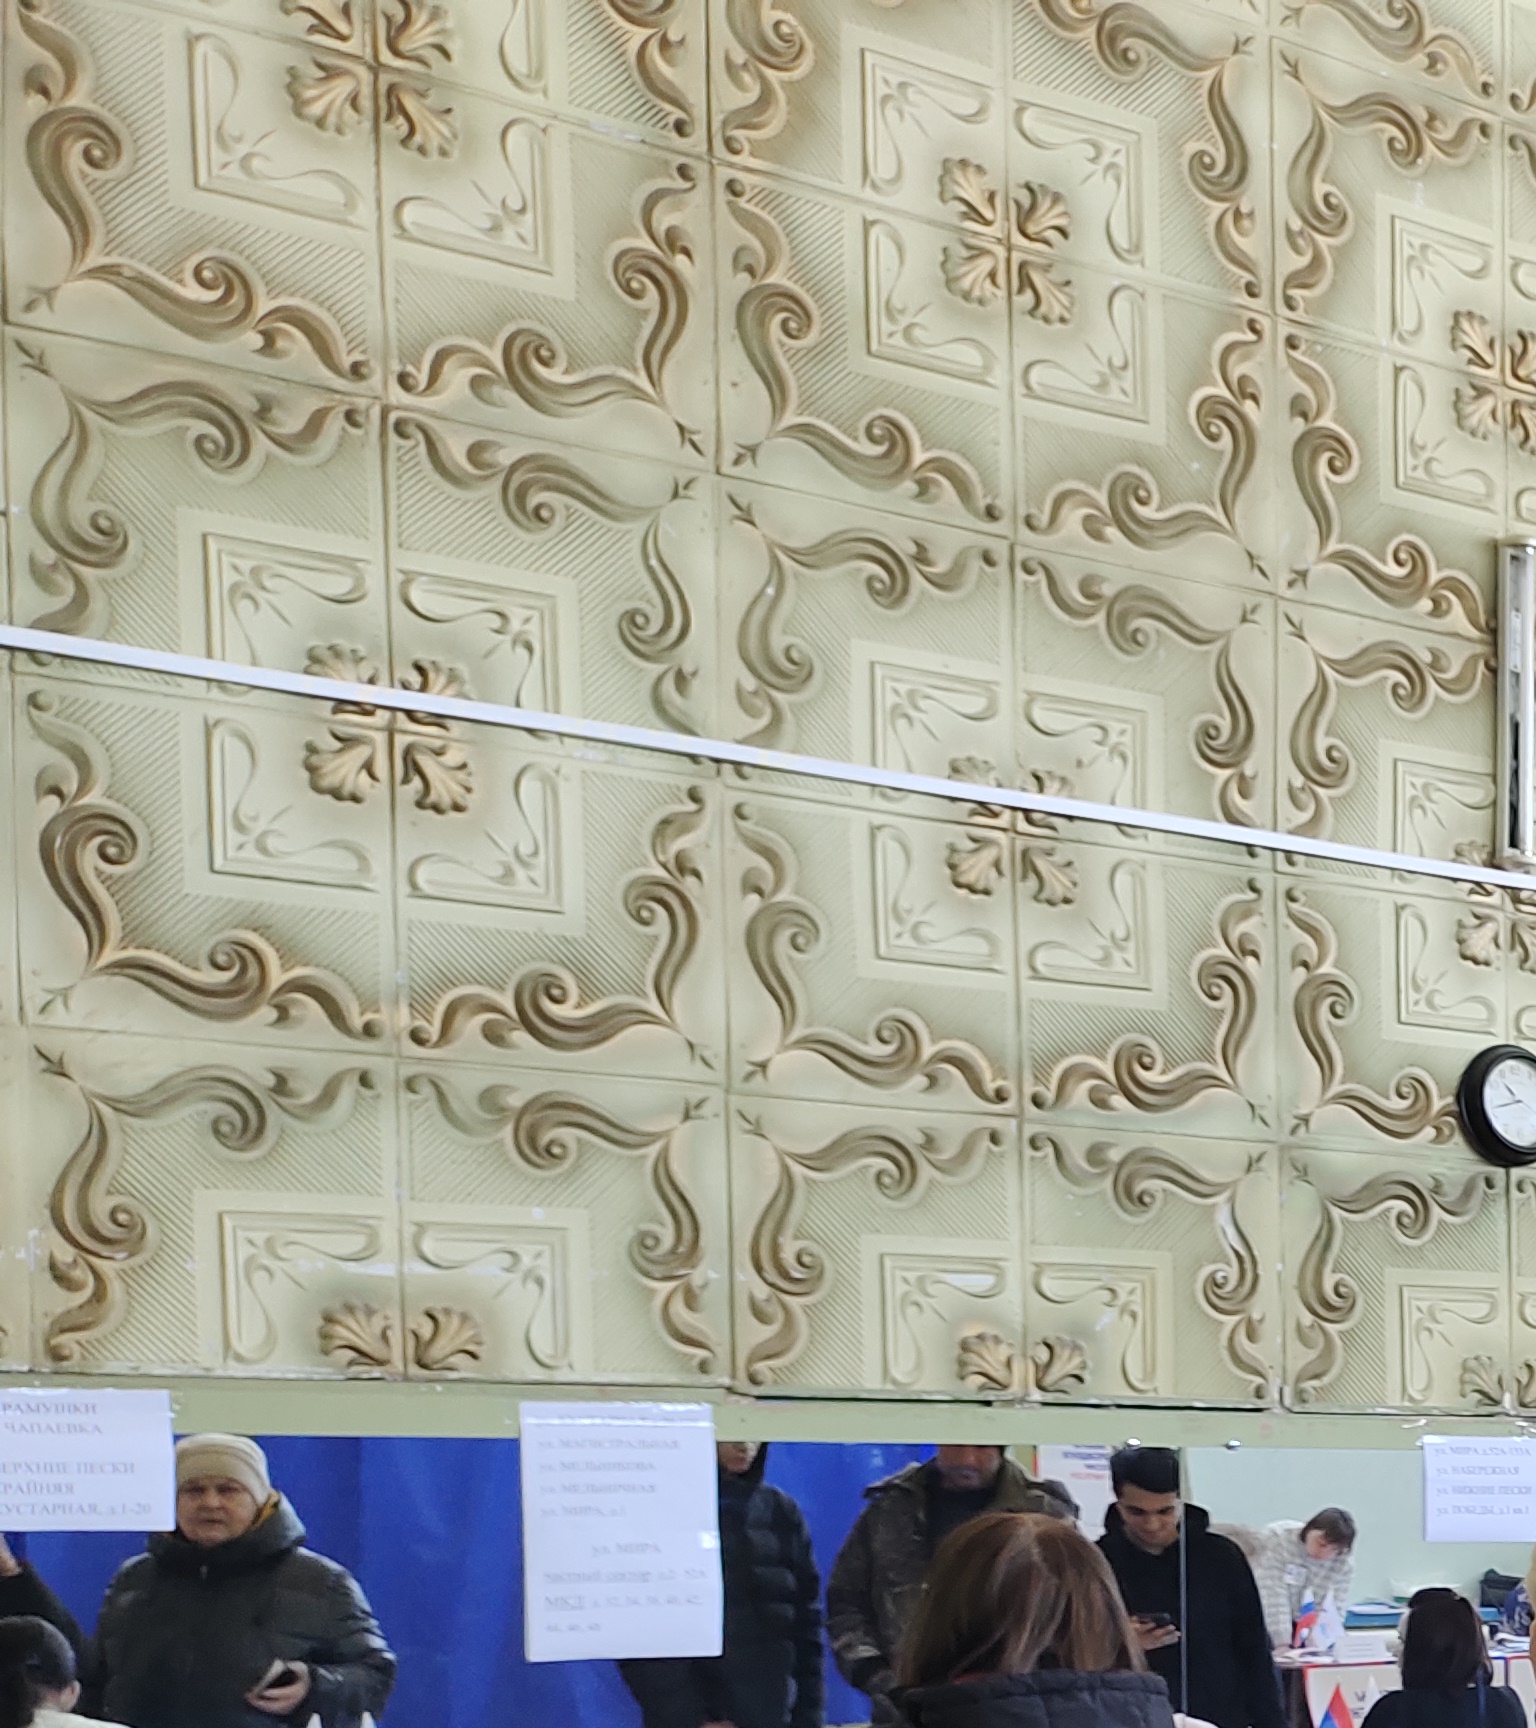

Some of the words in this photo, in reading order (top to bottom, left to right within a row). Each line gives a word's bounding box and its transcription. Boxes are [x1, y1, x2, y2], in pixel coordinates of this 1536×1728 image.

[5, 1422, 104, 1434] ЧАПАЕВКА
[0, 1461, 69, 1474] ЕРХНИЕ
[76, 1462, 135, 1474] ПЕСКИ
[0, 1480, 74, 1495] РАЙНЯЯ
